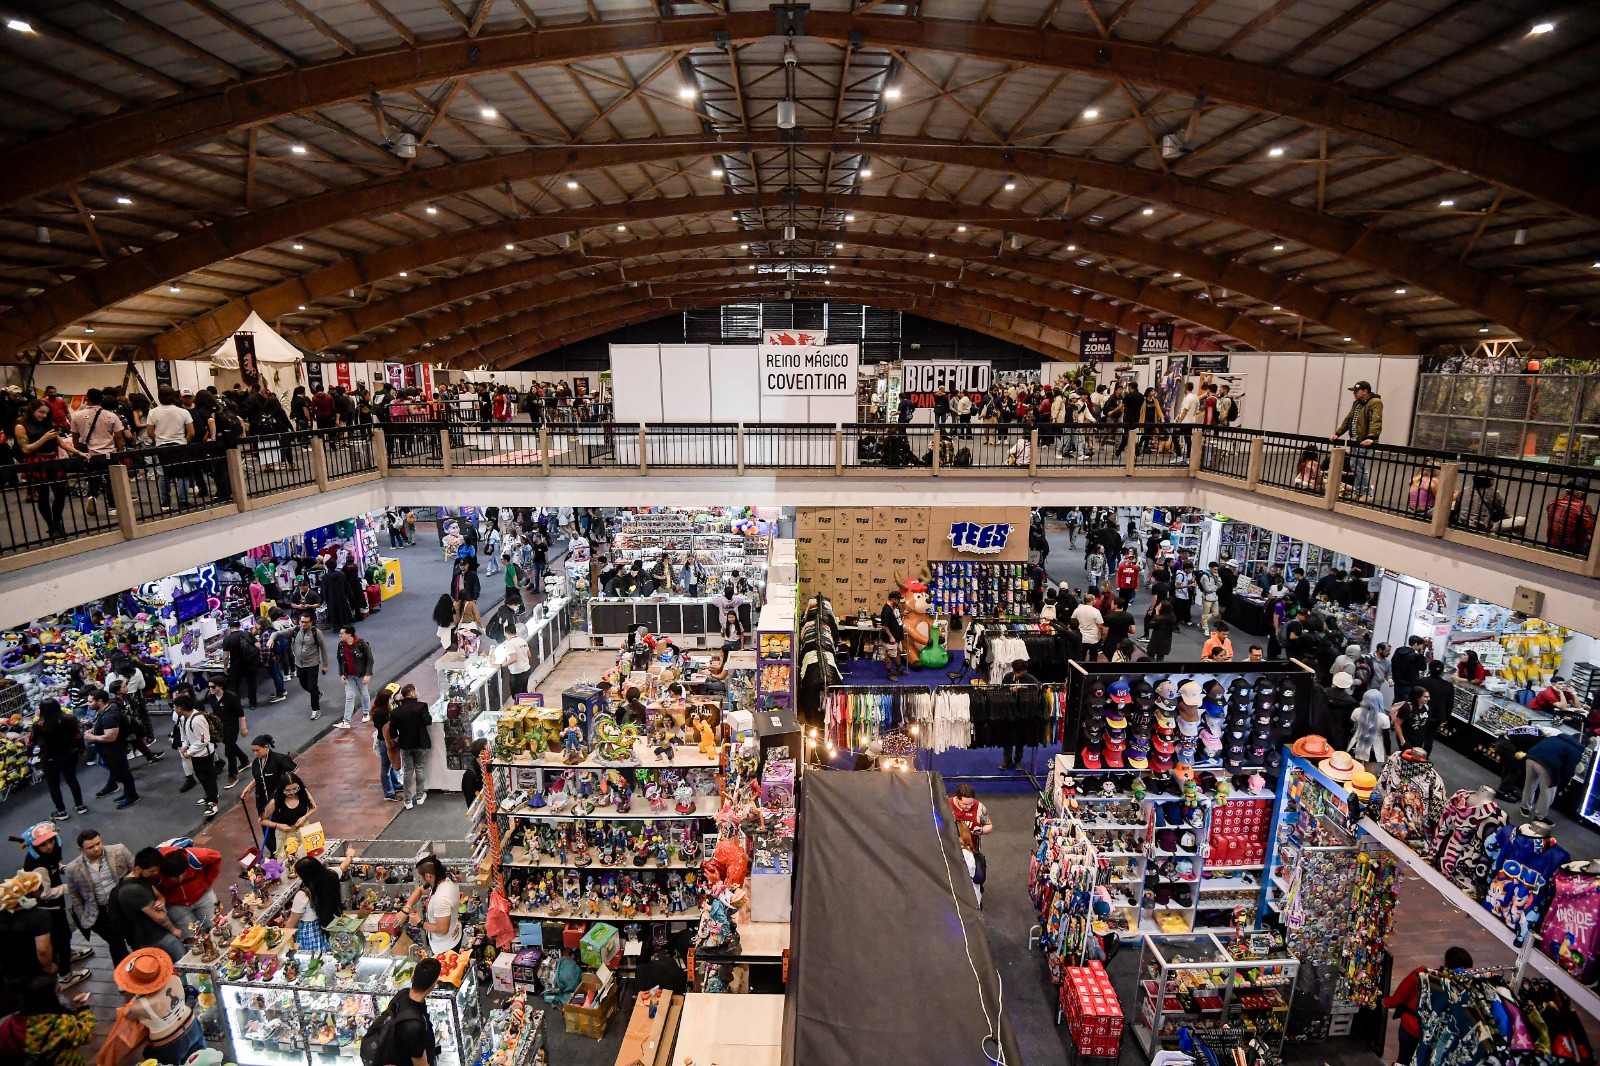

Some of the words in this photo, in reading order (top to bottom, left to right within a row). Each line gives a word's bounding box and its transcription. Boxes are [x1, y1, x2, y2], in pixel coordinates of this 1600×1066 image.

[1085, 344, 1111, 352] ZONA
[1143, 339, 1169, 348] ZONA
[767, 354, 800, 367] REINO
[805, 350, 848, 367] MÁGICO
[768, 374, 846, 390] COVENTINA
[905, 365, 988, 392] BICEFALO
[951, 522, 1009, 548] TEES
[1556, 904, 1596, 926] INSIDE
